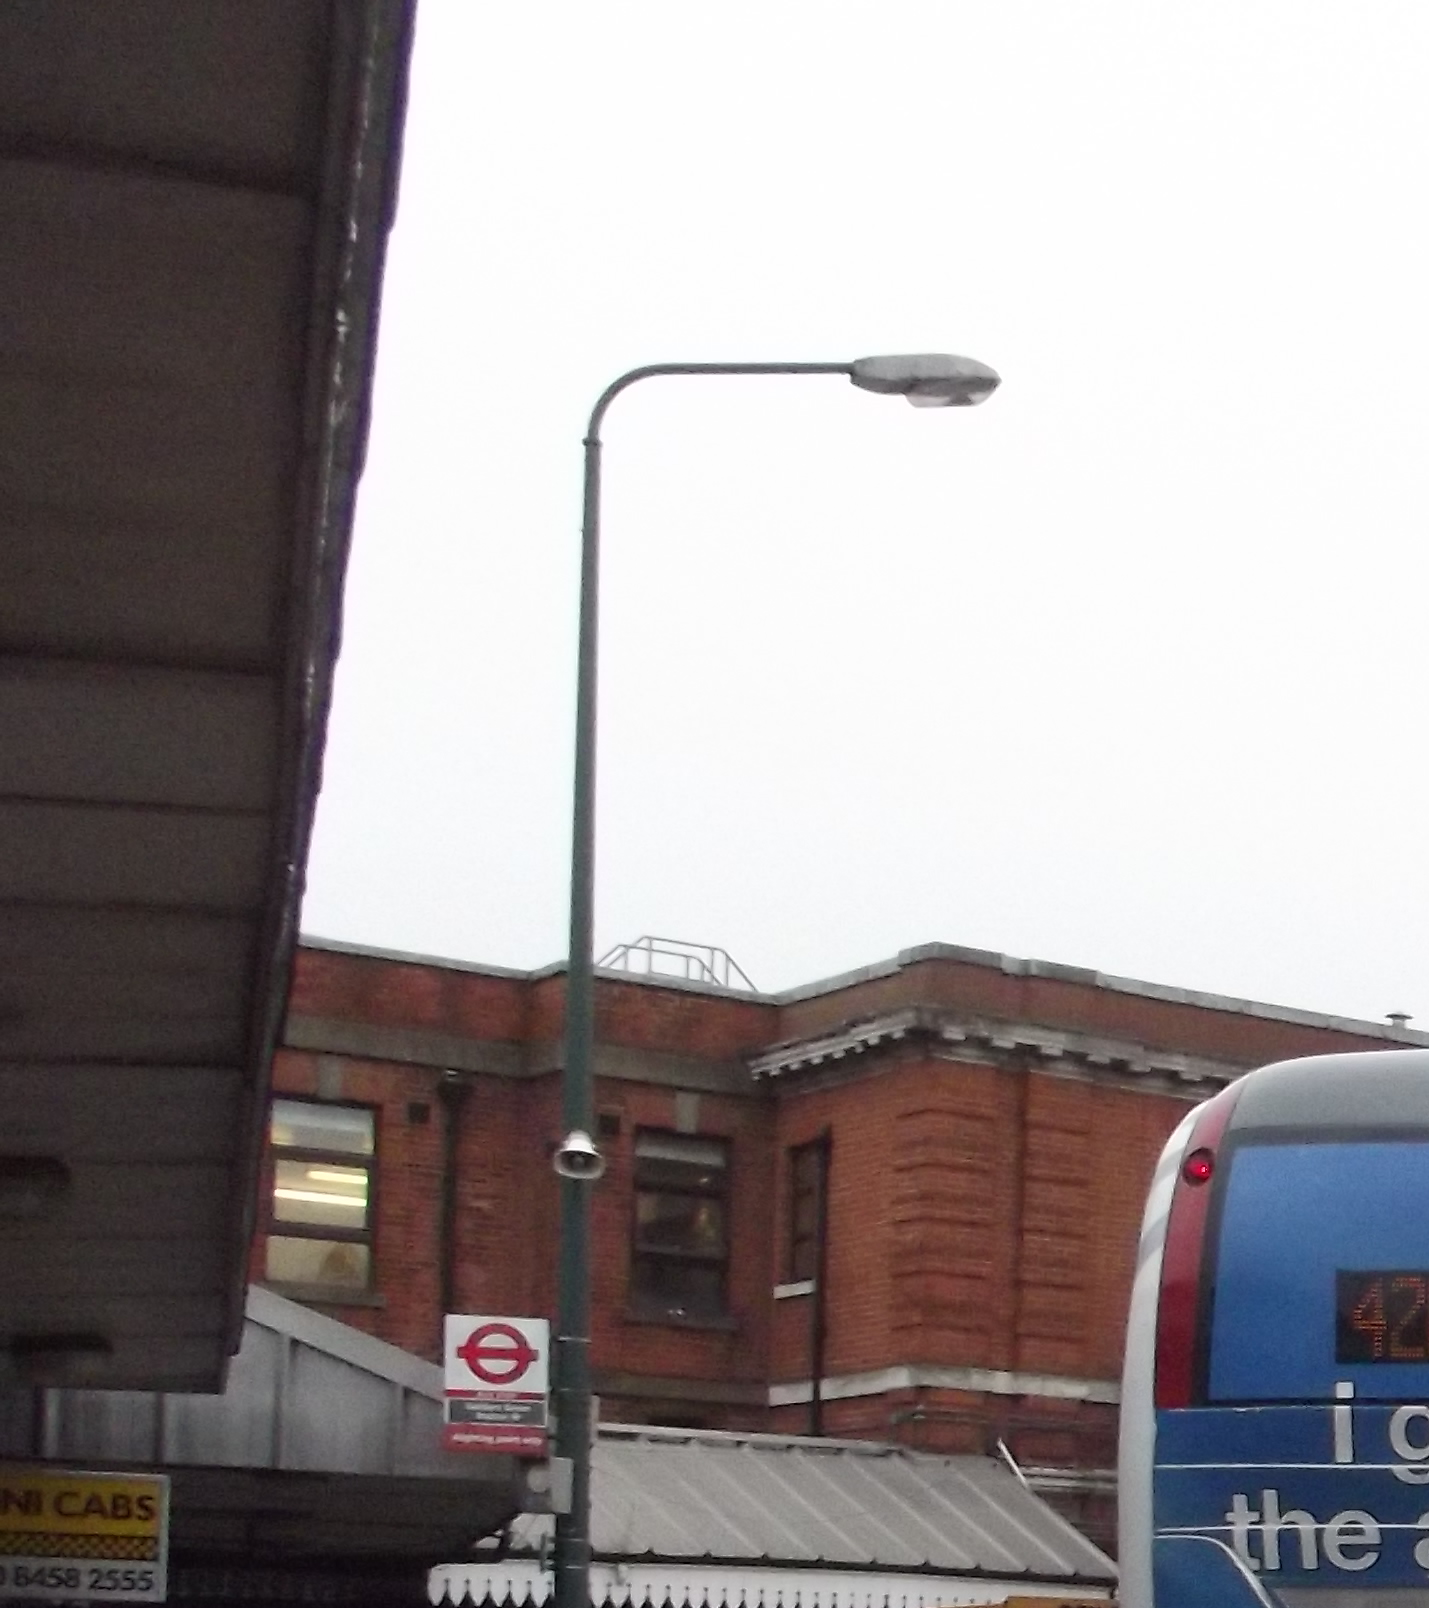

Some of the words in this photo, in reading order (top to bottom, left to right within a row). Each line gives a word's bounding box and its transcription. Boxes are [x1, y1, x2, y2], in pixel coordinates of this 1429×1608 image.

[1333, 1381, 1354, 1463] i
[53, 1491, 156, 1521] CABS
[1226, 1489, 1383, 1571] the
[88, 1569, 154, 1591] 2555
